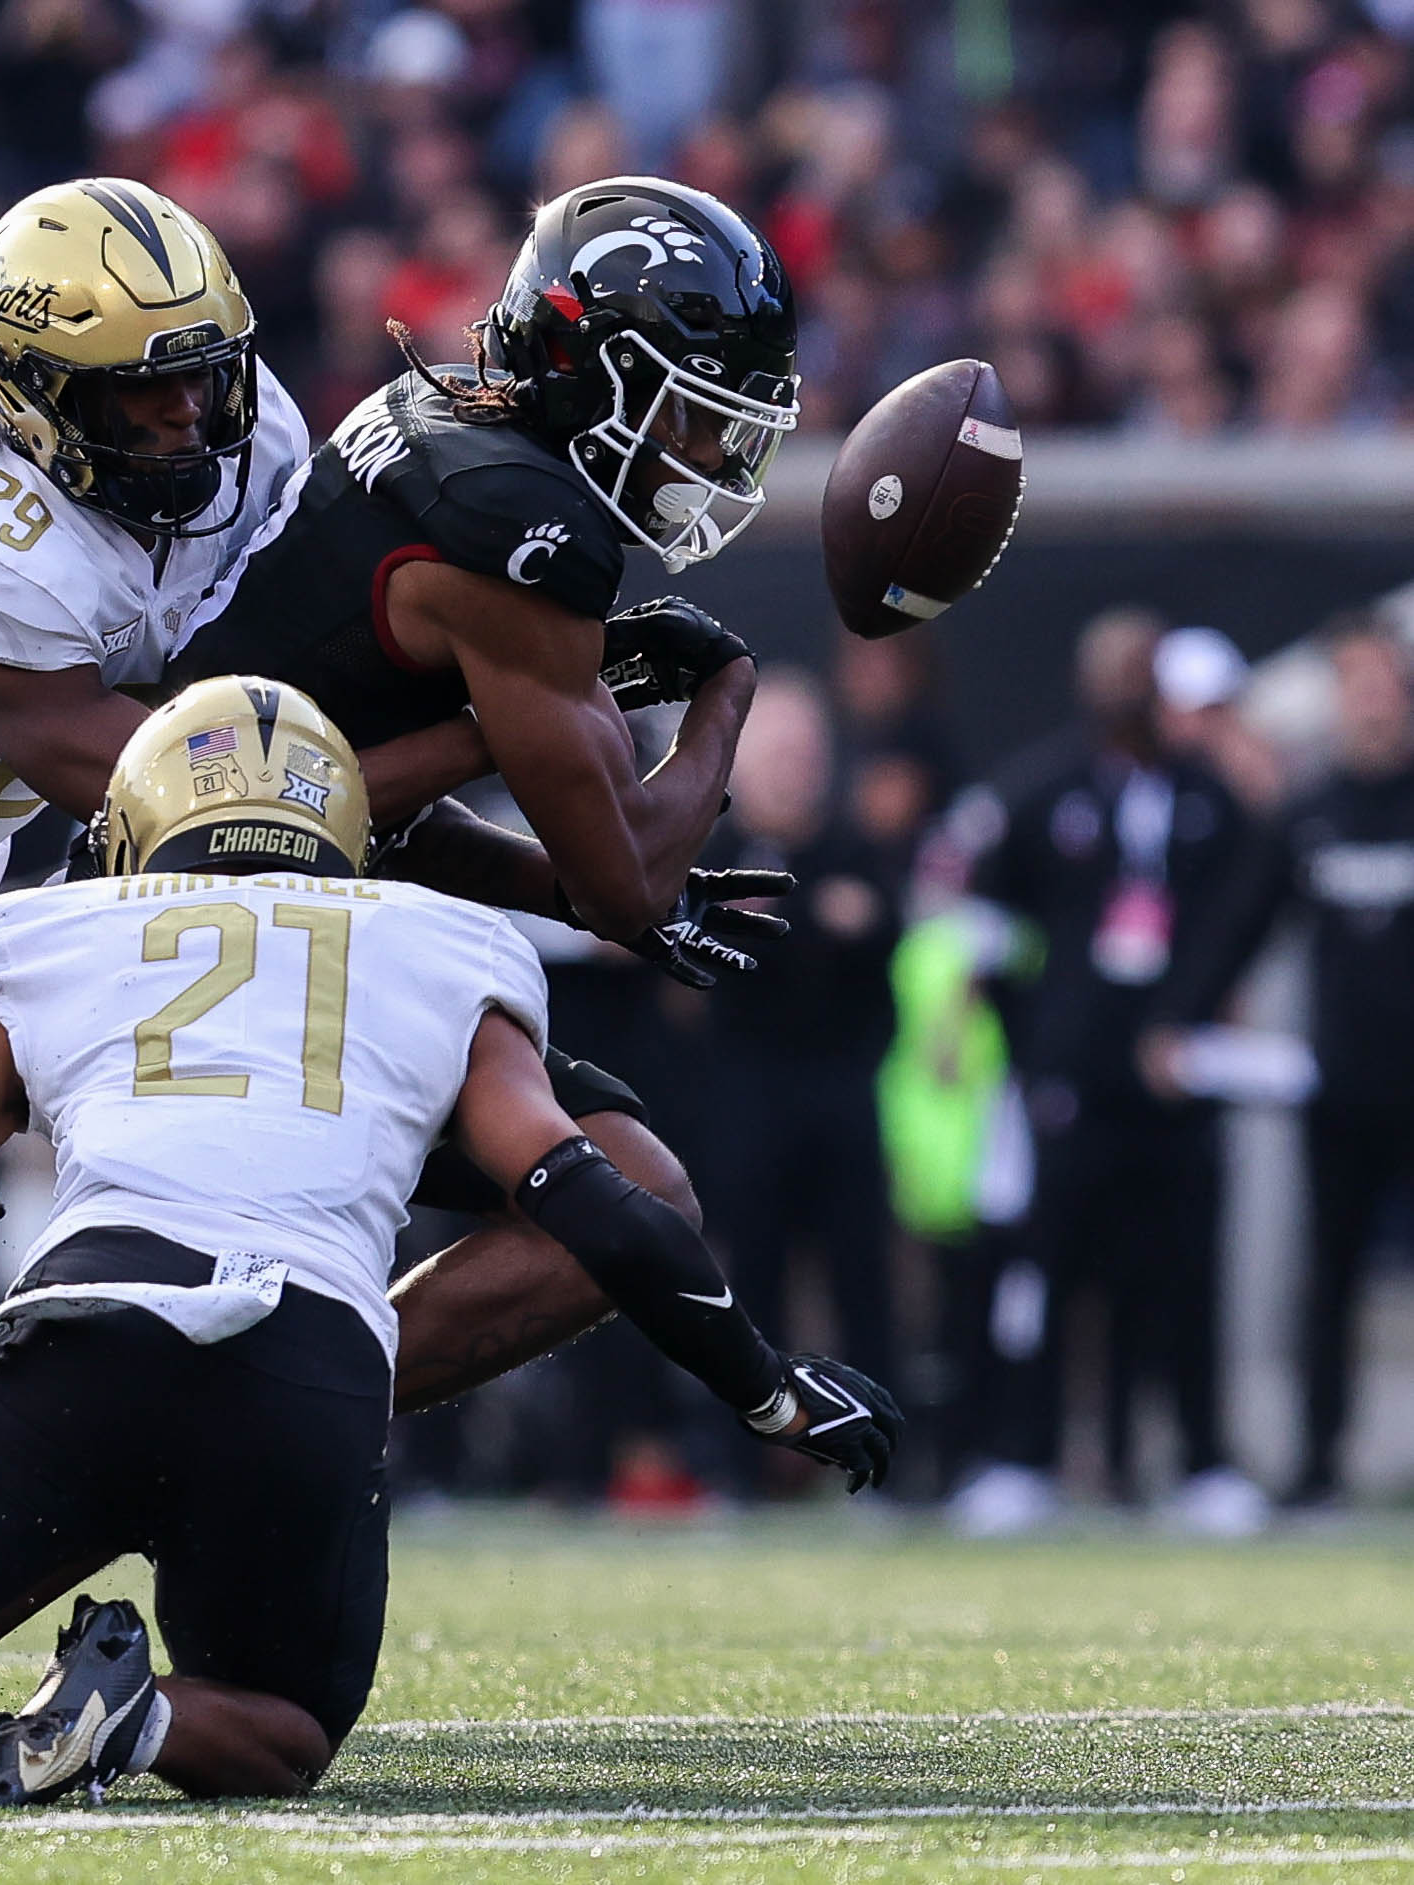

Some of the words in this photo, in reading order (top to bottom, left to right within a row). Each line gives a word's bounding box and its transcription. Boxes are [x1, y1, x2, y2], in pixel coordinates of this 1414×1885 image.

[874, 486, 891, 505] 138
[202, 777, 216, 791] 21
[278, 768, 330, 819] XII
[662, 920, 746, 969] ALPHA
[132, 901, 353, 1116] 21
